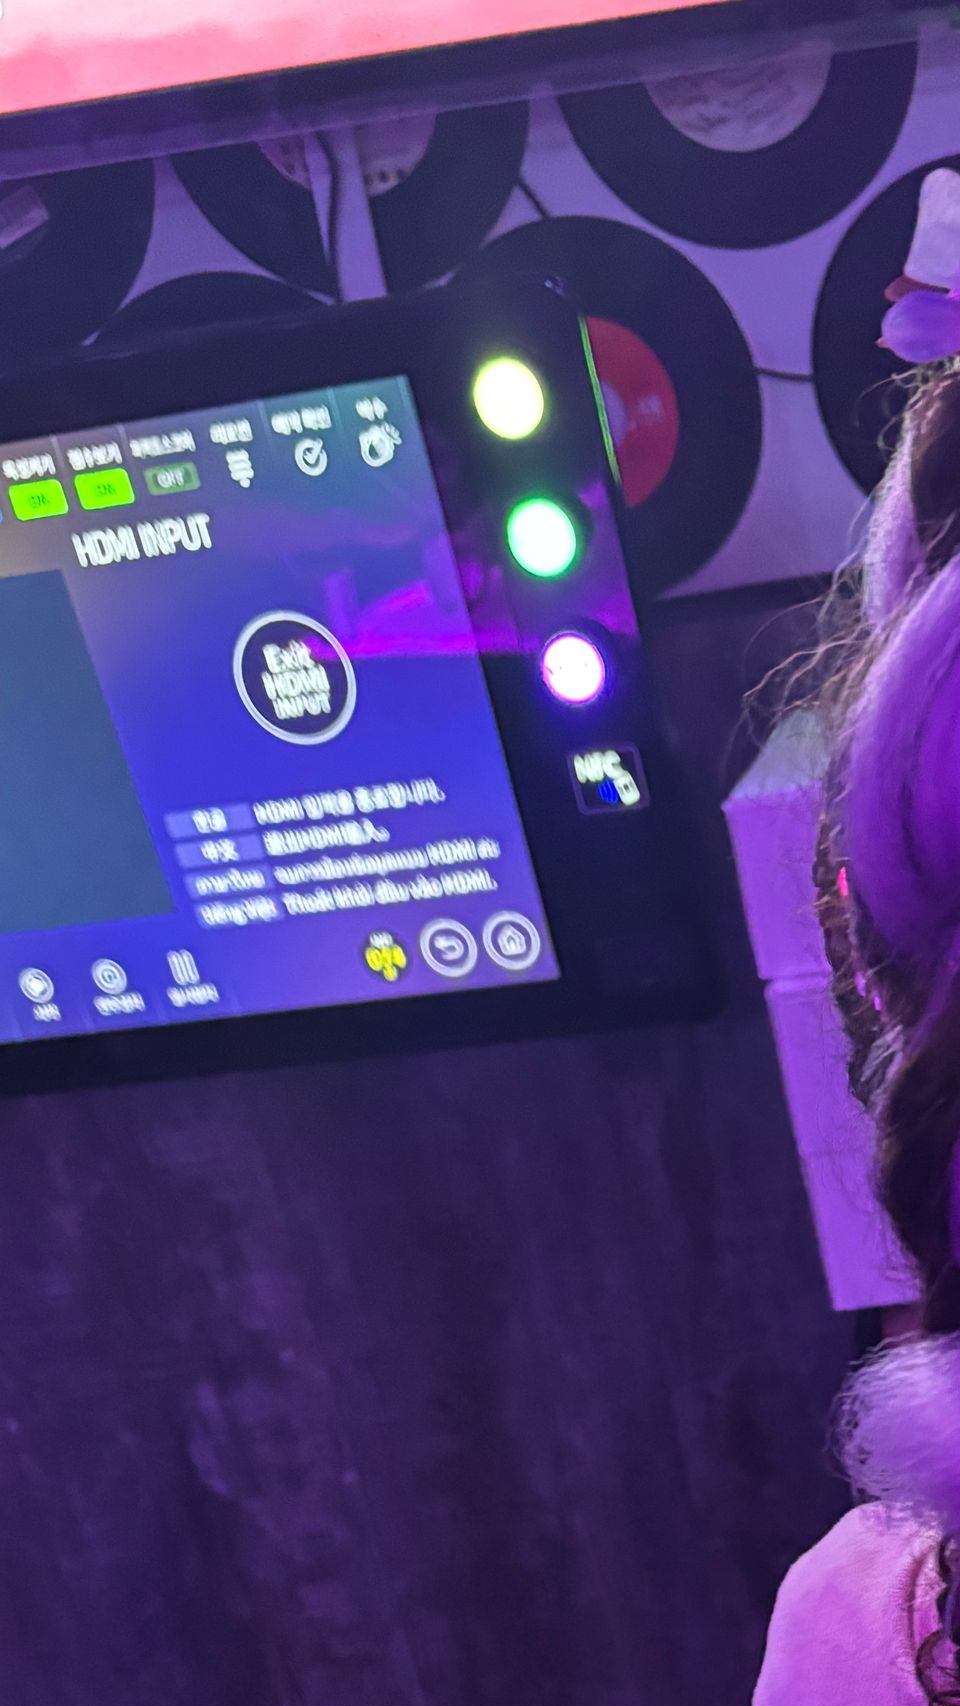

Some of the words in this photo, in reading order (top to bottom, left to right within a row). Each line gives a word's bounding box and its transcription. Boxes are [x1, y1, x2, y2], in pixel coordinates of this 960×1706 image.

[72, 525, 140, 568] HDMI
[137, 512, 212, 558] INPUT
[262, 640, 314, 674] Exit
[262, 663, 330, 701] HDMI
[272, 690, 331, 720] INPUT
[574, 750, 621, 784] NFC
[253, 796, 304, 825] HDMI
[426, 837, 479, 866] HDMI
